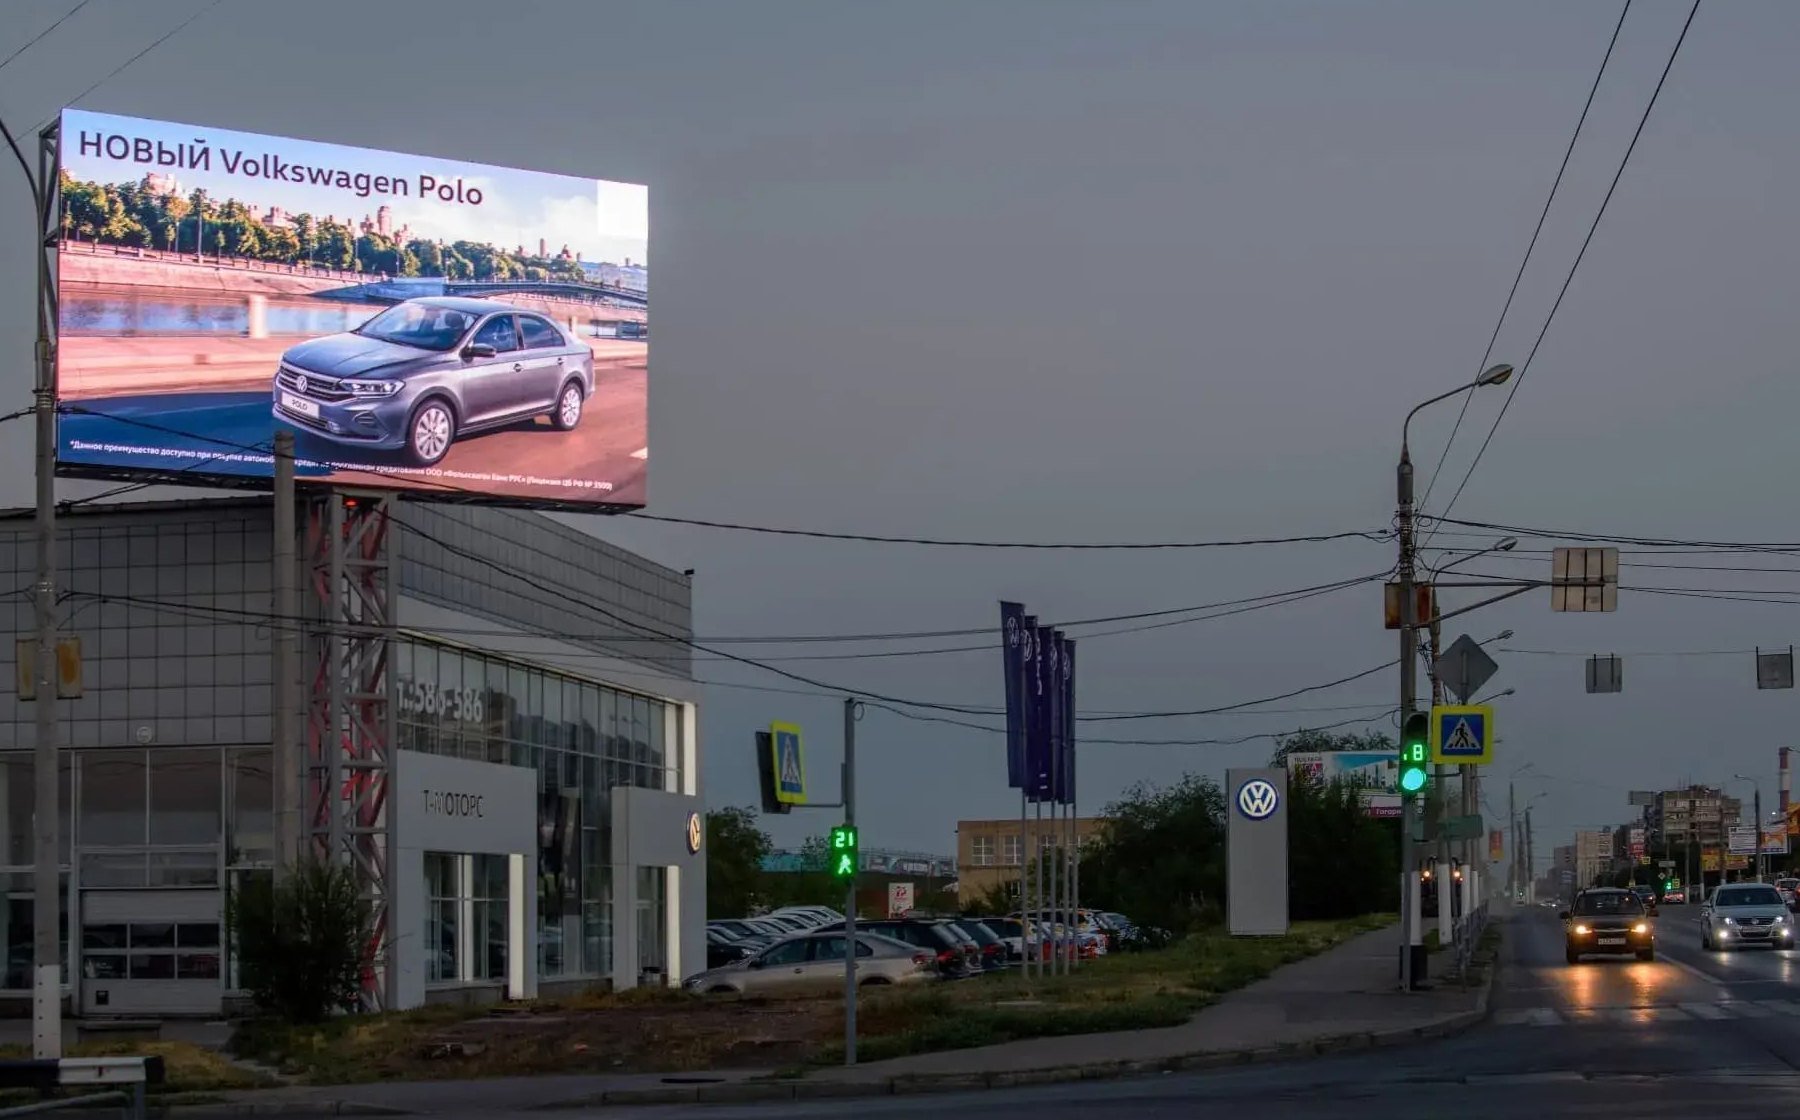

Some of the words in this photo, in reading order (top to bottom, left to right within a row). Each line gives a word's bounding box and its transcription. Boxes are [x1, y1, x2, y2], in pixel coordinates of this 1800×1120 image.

[79, 130, 211, 172] НОВЫЙ
[220, 148, 409, 198] Volkswagen
[419, 175, 484, 206] Polo
[292, 400, 308, 410] POLO
[104, 443, 160, 456] преимущество
[426, 468, 443, 476] ООО
[424, 789, 483, 817] Т-МОТОРС
[1237, 779, 1279, 821] VW
[835, 831, 854, 848] 21
